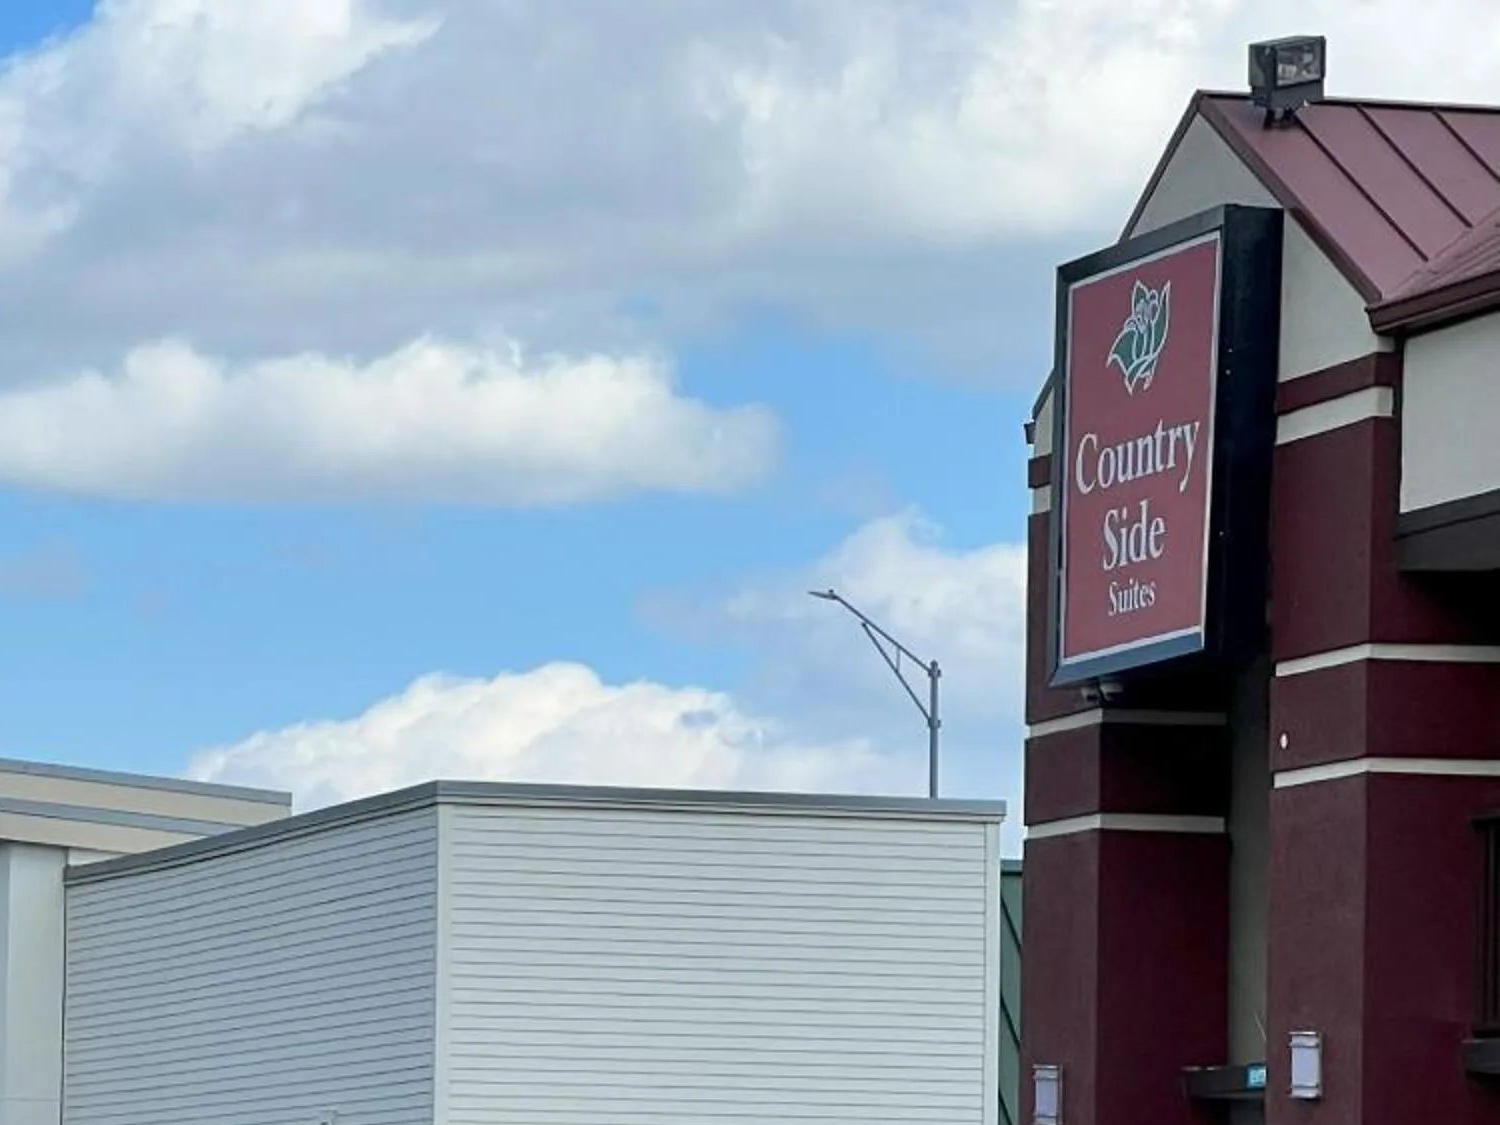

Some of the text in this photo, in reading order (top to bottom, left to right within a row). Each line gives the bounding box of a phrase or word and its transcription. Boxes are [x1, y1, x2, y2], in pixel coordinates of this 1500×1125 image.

[1075, 419, 1200, 495] Country
[1103, 500, 1167, 572] Side
[1108, 578, 1156, 616] Suites
